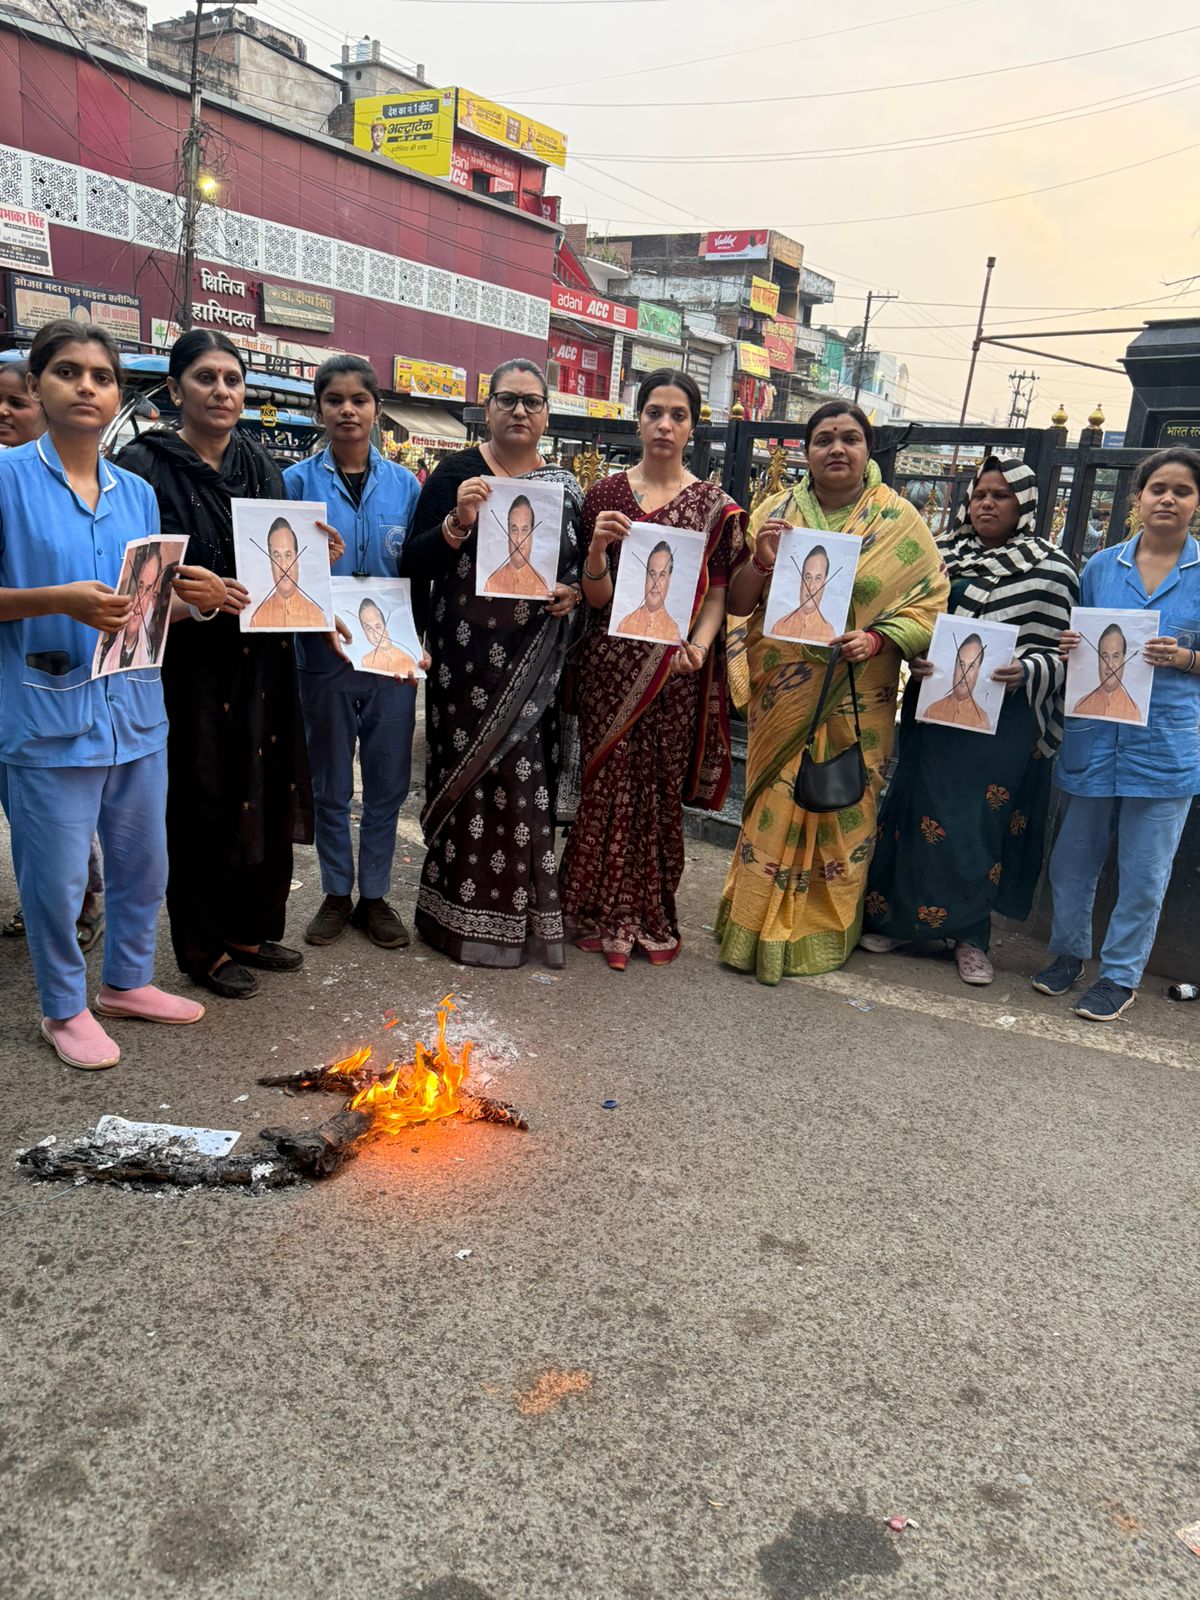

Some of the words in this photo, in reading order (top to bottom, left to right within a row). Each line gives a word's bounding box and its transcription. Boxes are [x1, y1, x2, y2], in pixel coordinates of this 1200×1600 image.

[451, 151, 469, 171] dani
[449, 168, 468, 186] CC
[15, 276, 42, 289] ओजस
[44, 283, 62, 293] मदर
[200, 267, 247, 298] क्षितिज
[191, 299, 257, 331] हास्पिटल
[557, 292, 583, 311] adani
[587, 300, 610, 319] ACC
[557, 344, 578, 361] ACC
[1167, 426, 1189, 438] भारत
[1190, 426, 1200, 438] रत्
